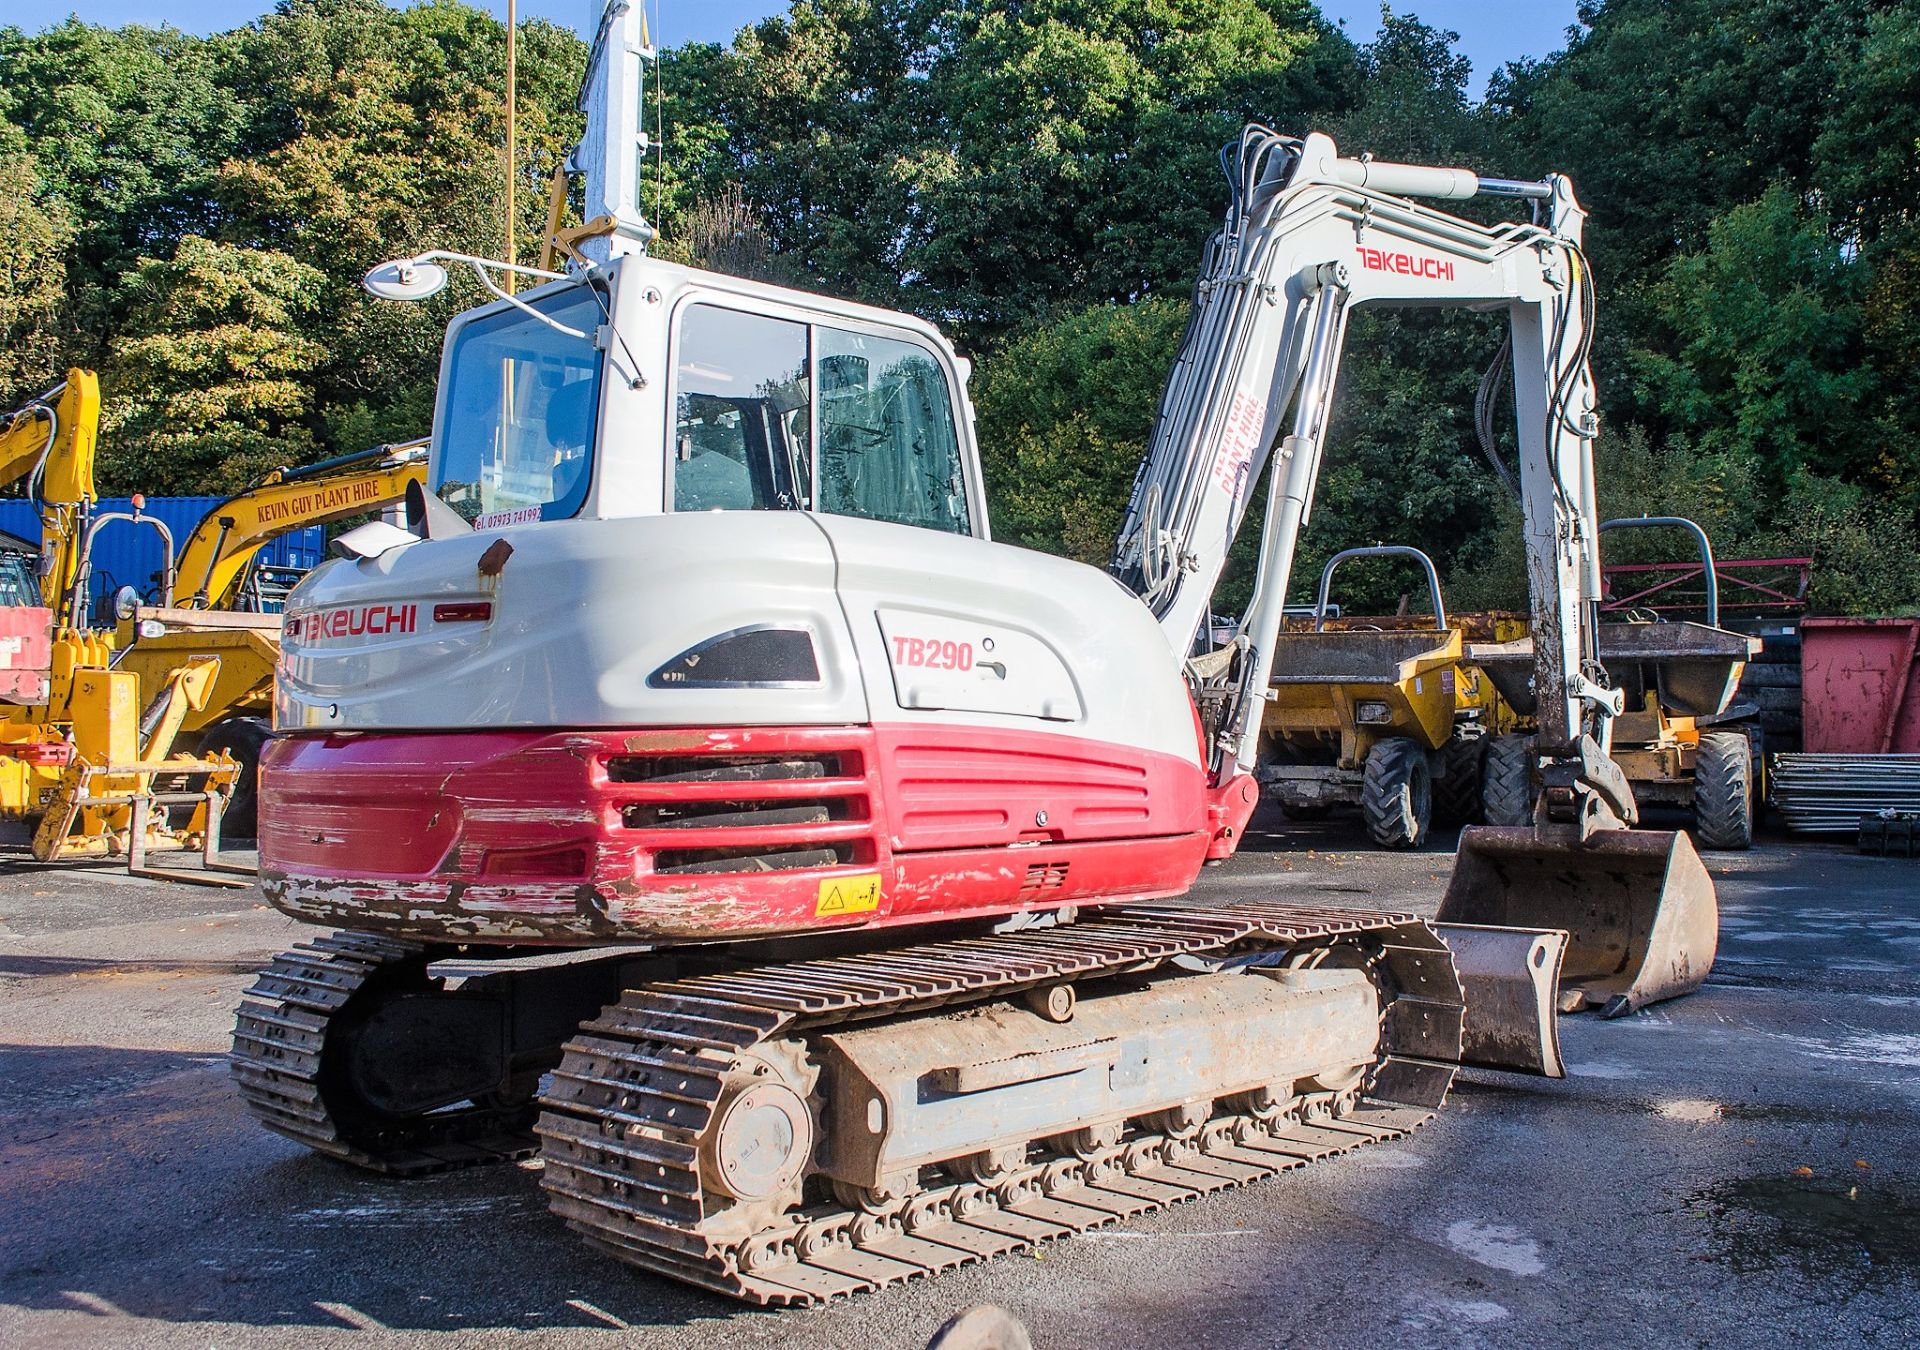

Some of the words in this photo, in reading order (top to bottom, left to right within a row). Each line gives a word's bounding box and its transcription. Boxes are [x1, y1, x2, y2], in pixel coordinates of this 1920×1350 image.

[1221, 436, 1245, 494] PLANT
[1239, 395, 1259, 437] HIRE
[257, 500, 289, 523] KEVIN
[291, 495, 313, 515] GUY
[314, 486, 350, 510] PLANT
[352, 480, 379, 501] HIRE
[488, 512, 511, 528] 07973
[513, 507, 542, 523] 741992
[893, 636, 973, 671] TB290
